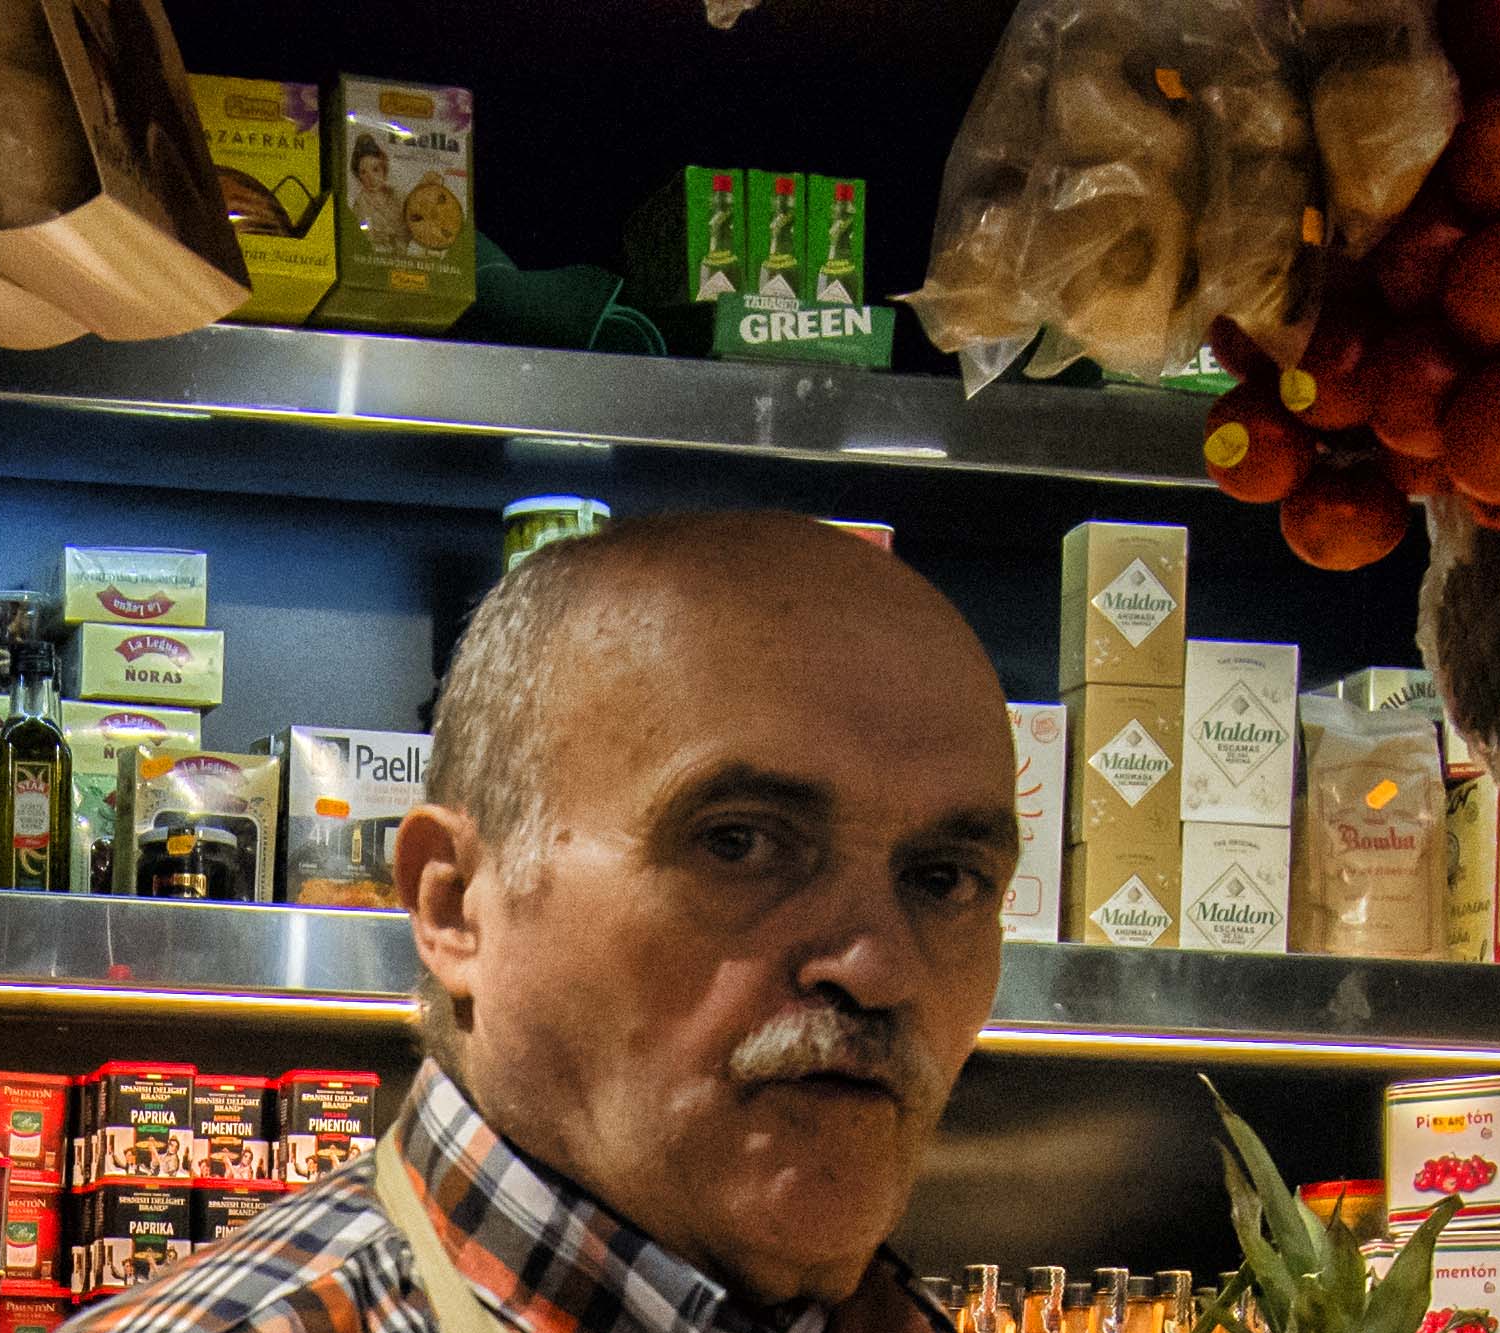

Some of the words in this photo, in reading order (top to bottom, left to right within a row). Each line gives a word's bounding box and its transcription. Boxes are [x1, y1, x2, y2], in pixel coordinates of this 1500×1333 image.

[739, 304, 873, 345] GREEN
[1102, 591, 1177, 613] Maldon
[125, 666, 183, 685] ÑORAS
[1200, 720, 1284, 745] Maldon
[1100, 752, 1170, 774] Maldon
[1100, 907, 1170, 928] Maldon
[1195, 902, 1278, 926] Maldon
[130, 1109, 177, 1125] PAPRIKA
[308, 1118, 361, 1134] PIMENTON
[200, 1121, 253, 1137] PIMENTON
[129, 1220, 175, 1236] PAPRIKA
